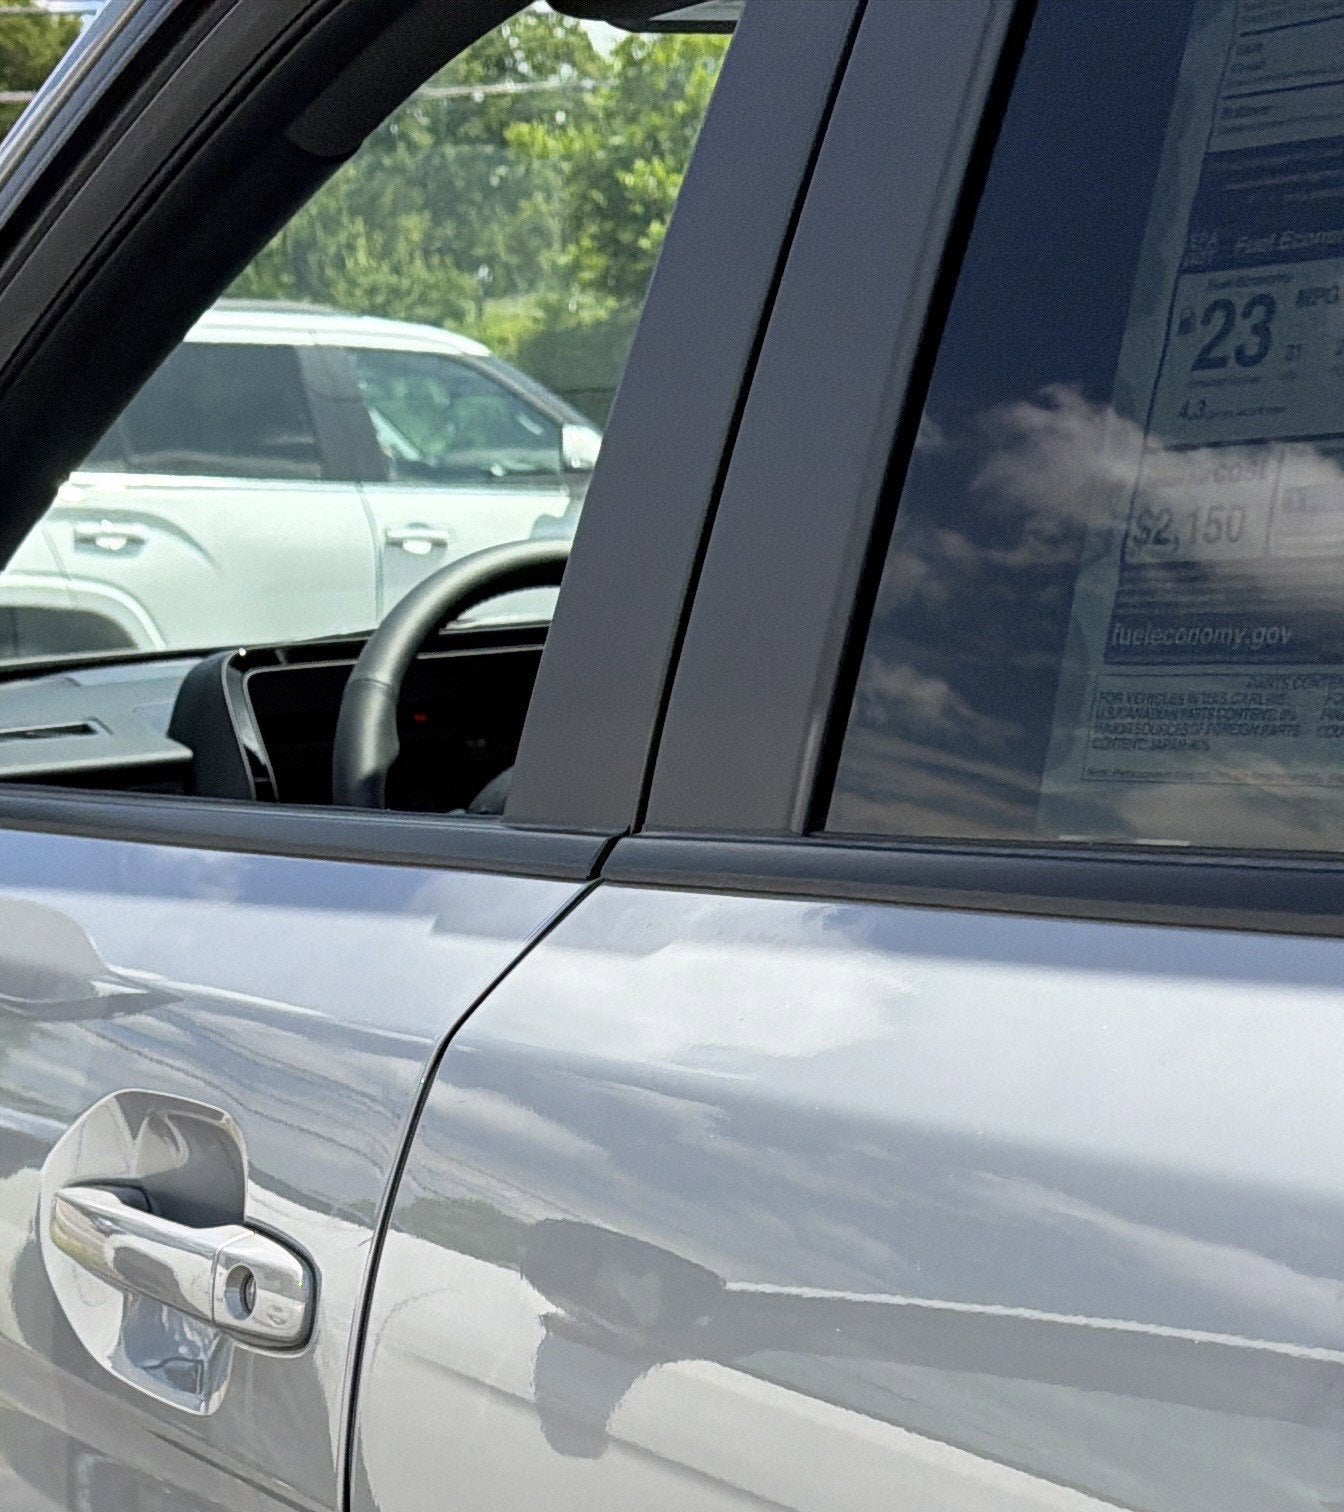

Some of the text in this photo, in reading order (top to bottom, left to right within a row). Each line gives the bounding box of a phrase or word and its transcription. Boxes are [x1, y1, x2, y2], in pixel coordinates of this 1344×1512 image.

[1190, 293, 1277, 372] 23
[1131, 504, 1247, 553] $2,150
[1110, 618, 1294, 650] fueleconomy.gov
